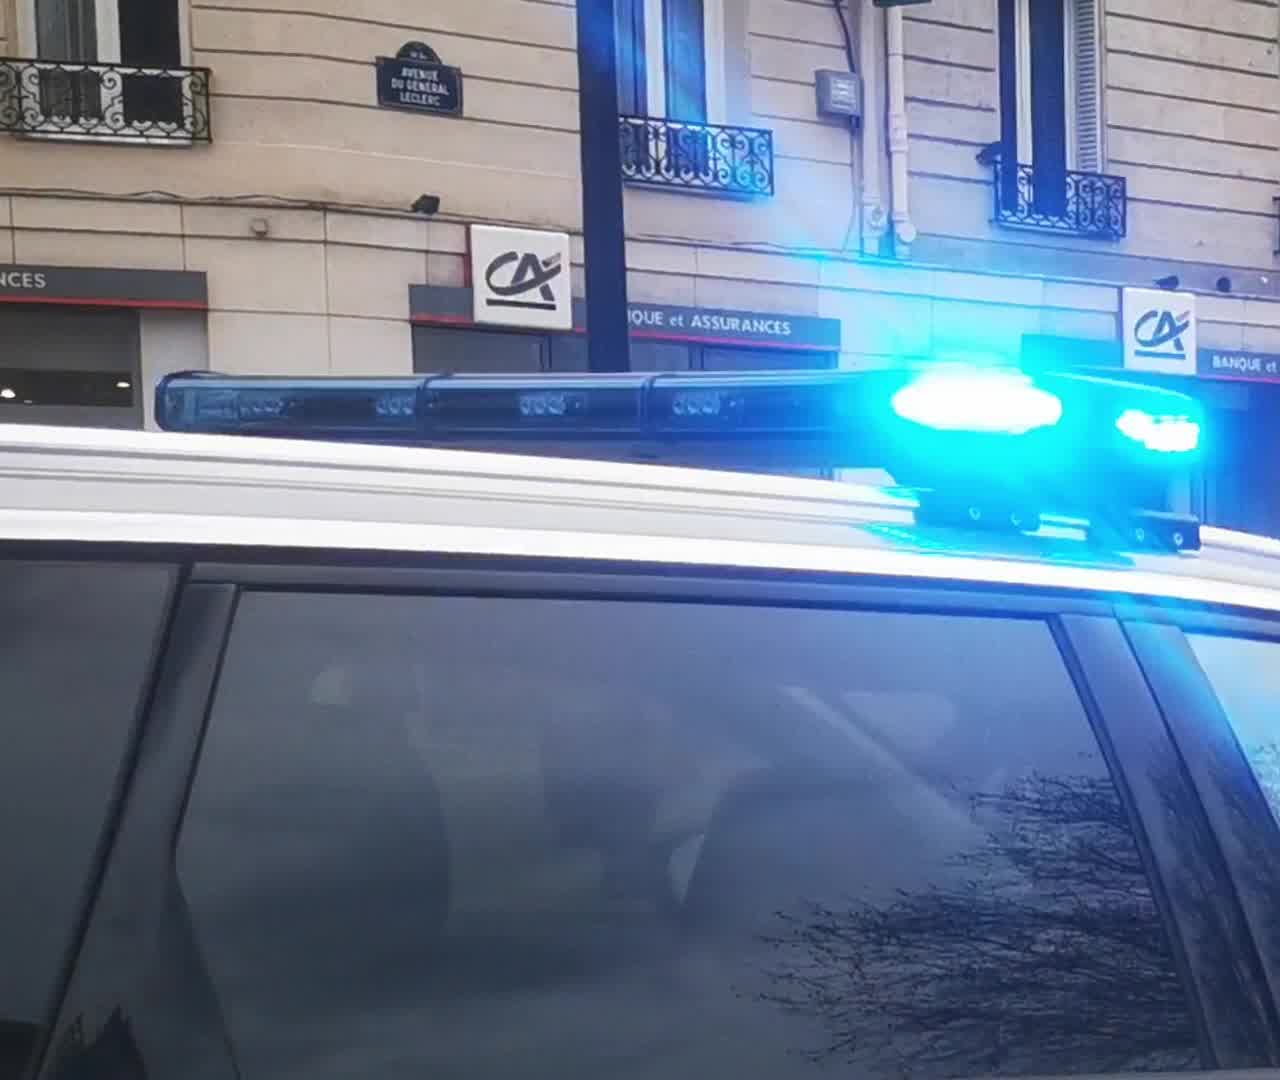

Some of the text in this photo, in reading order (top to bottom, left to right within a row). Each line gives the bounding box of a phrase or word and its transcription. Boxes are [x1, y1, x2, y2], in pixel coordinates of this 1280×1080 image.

[399, 91, 441, 106] LECLERC
[669, 315, 684, 328] et
[690, 316, 792, 336] ASSURANCES
[1211, 355, 1262, 374] BANQUE
[1265, 358, 1277, 373] et
